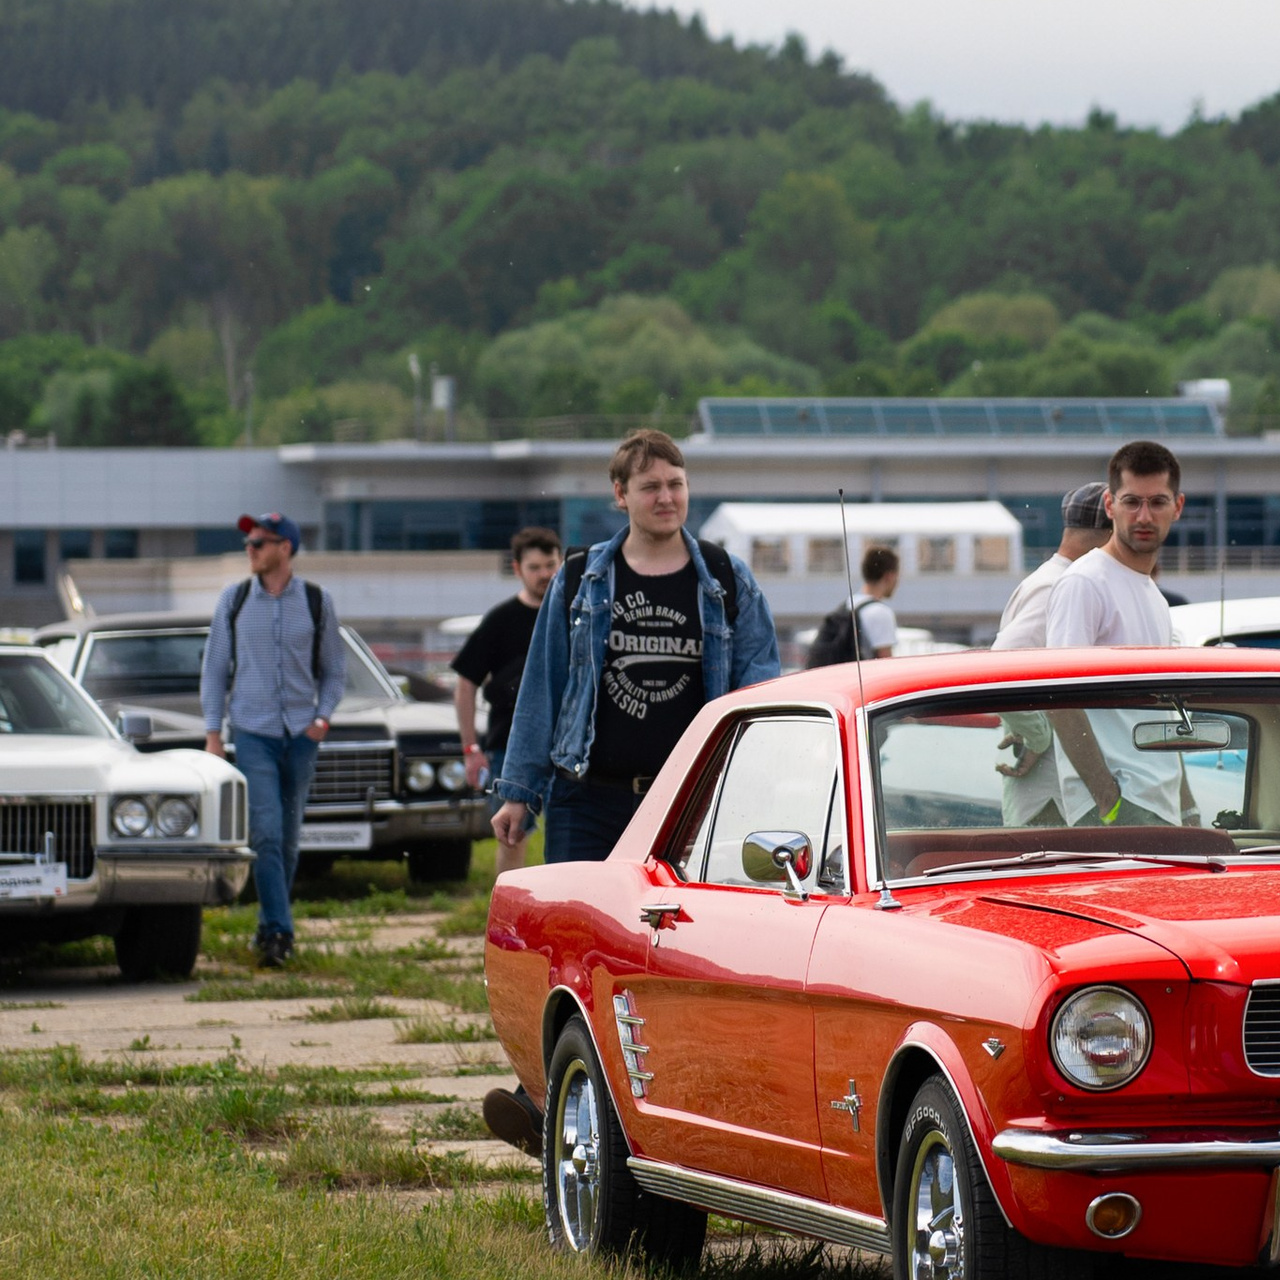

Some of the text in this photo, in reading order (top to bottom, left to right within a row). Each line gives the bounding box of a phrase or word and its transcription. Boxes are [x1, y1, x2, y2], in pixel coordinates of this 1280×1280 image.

[625, 591, 650, 609] CO.
[623, 605, 687, 625] DENIM BRAND
[603, 671, 648, 720] CUSTOM
[617, 671, 690, 702] QUALITY GARMENTS
